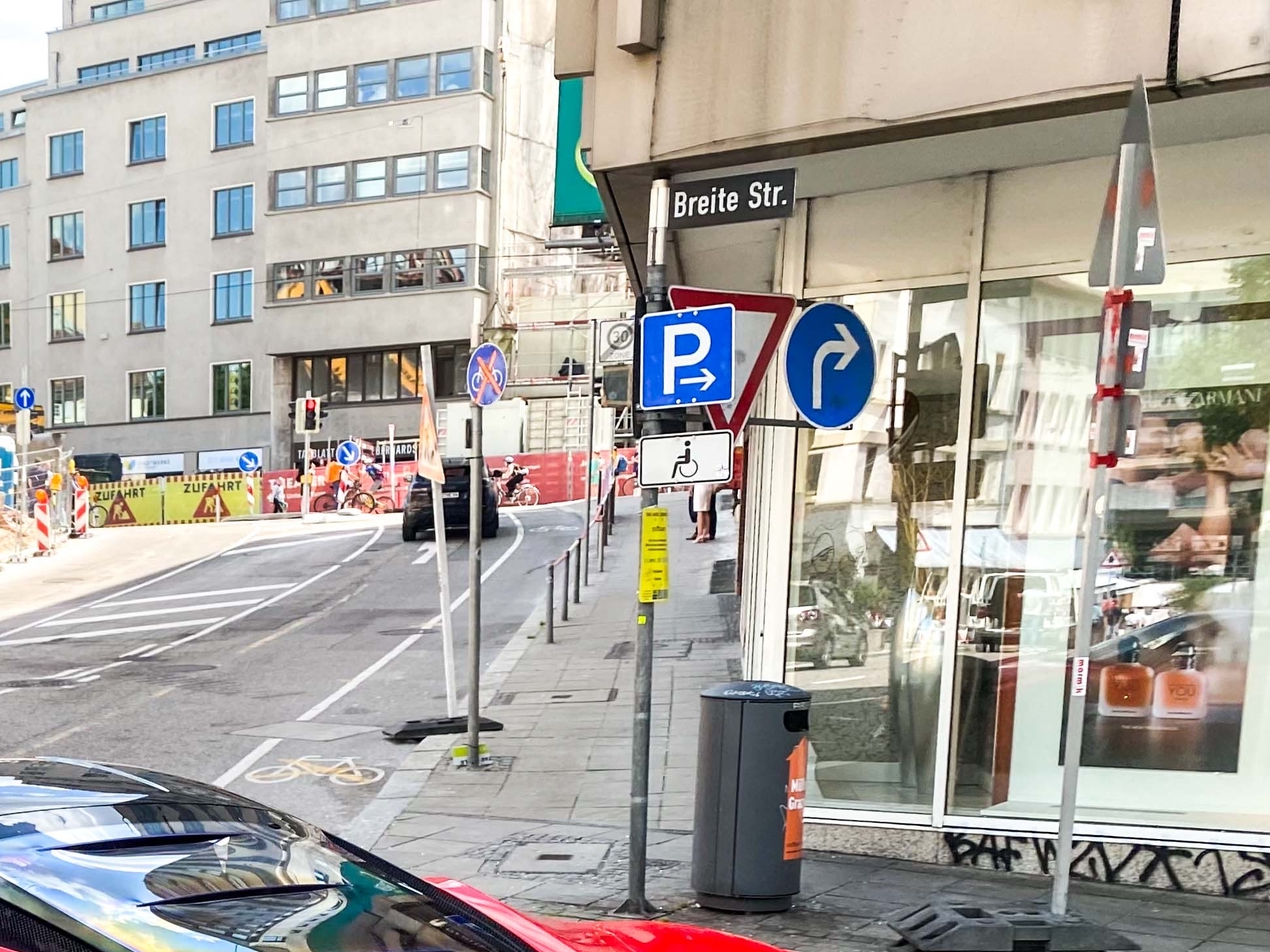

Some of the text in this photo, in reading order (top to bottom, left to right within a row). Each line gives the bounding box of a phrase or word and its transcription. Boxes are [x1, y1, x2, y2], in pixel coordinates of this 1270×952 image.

[673, 181, 788, 218] Breite Str.
[612, 329, 630, 344] 30
[1194, 387, 1263, 408] ARMANI
